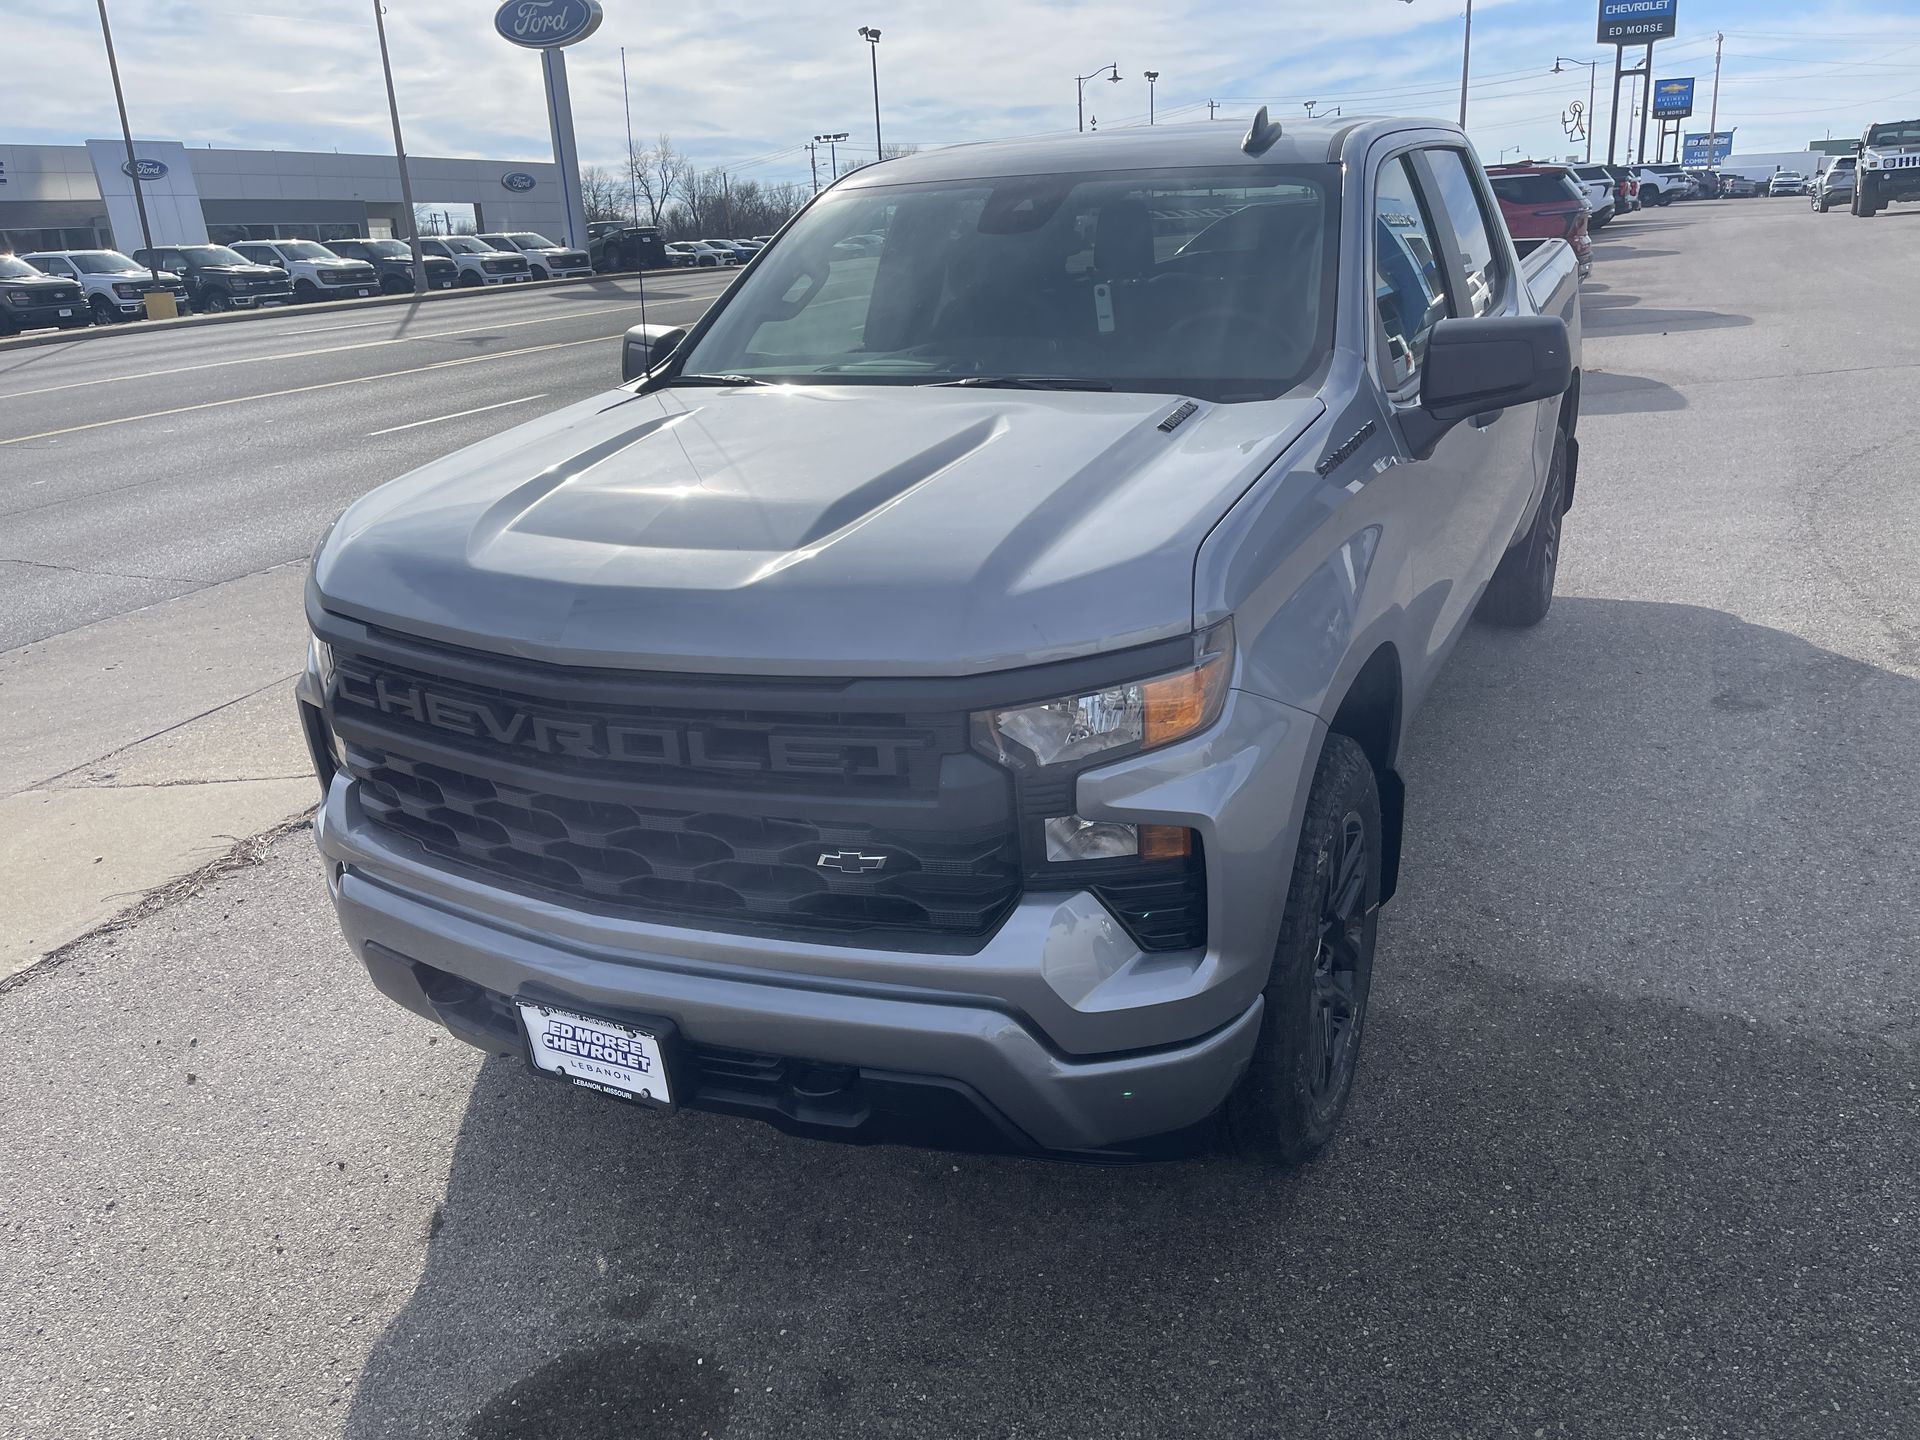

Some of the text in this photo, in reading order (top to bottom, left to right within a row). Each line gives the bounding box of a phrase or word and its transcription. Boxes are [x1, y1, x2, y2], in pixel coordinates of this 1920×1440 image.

[514, 1, 569, 35] Ford
[1605, 0, 1670, 15] CHEVROLET
[1609, 23, 1664, 36] ED MORSE
[136, 162, 161, 175] Ford
[336, 666, 925, 776] CHEVROLET
[549, 1021, 643, 1056] ED MORSE
[542, 1033, 650, 1072] CHEVROLET
[570, 1060, 631, 1082] LEBANON
[573, 1079, 632, 1100] LEBANON, MISSOURI
